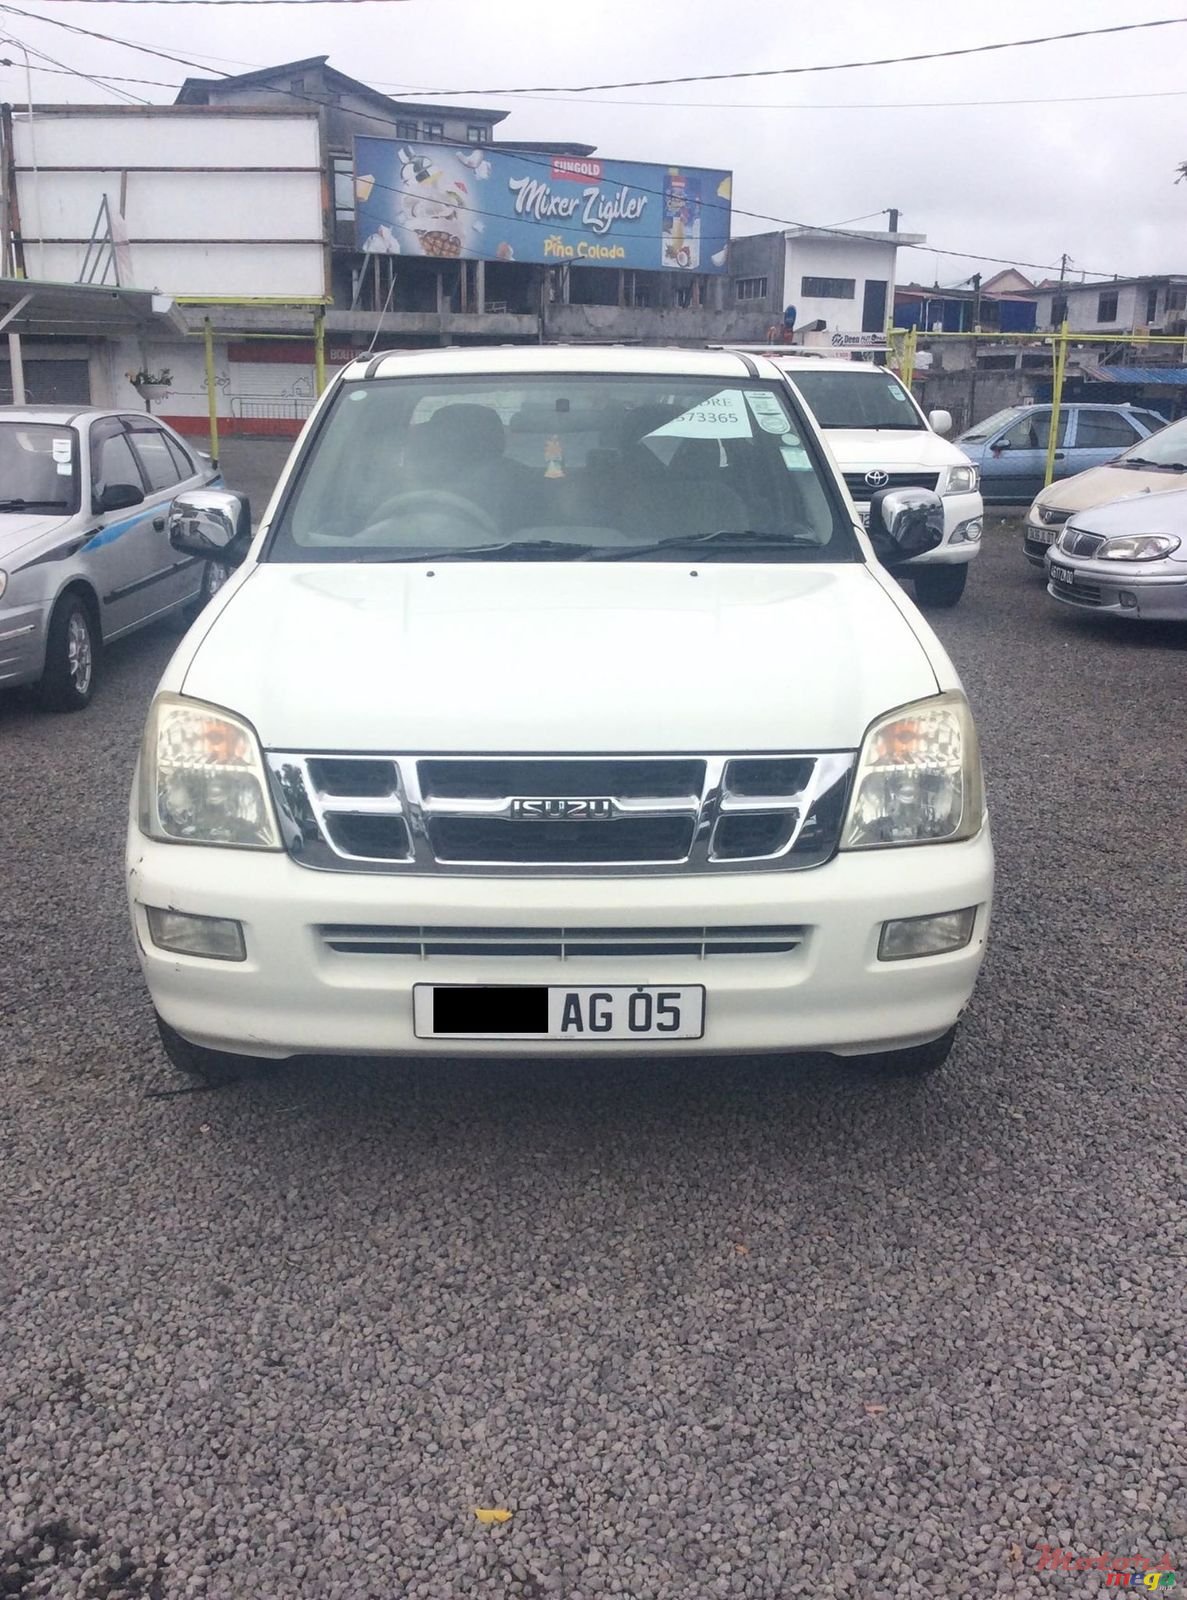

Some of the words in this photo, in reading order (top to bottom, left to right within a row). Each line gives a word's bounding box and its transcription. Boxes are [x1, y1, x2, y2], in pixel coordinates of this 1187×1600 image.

[553, 160, 601, 176] SUNGOLD
[509, 176, 580, 220] Mixer
[577, 241, 625, 258] Colada
[513, 800, 610, 818] ISUZU
[560, 993, 613, 1032] AG
[628, 993, 681, 1032] 05
